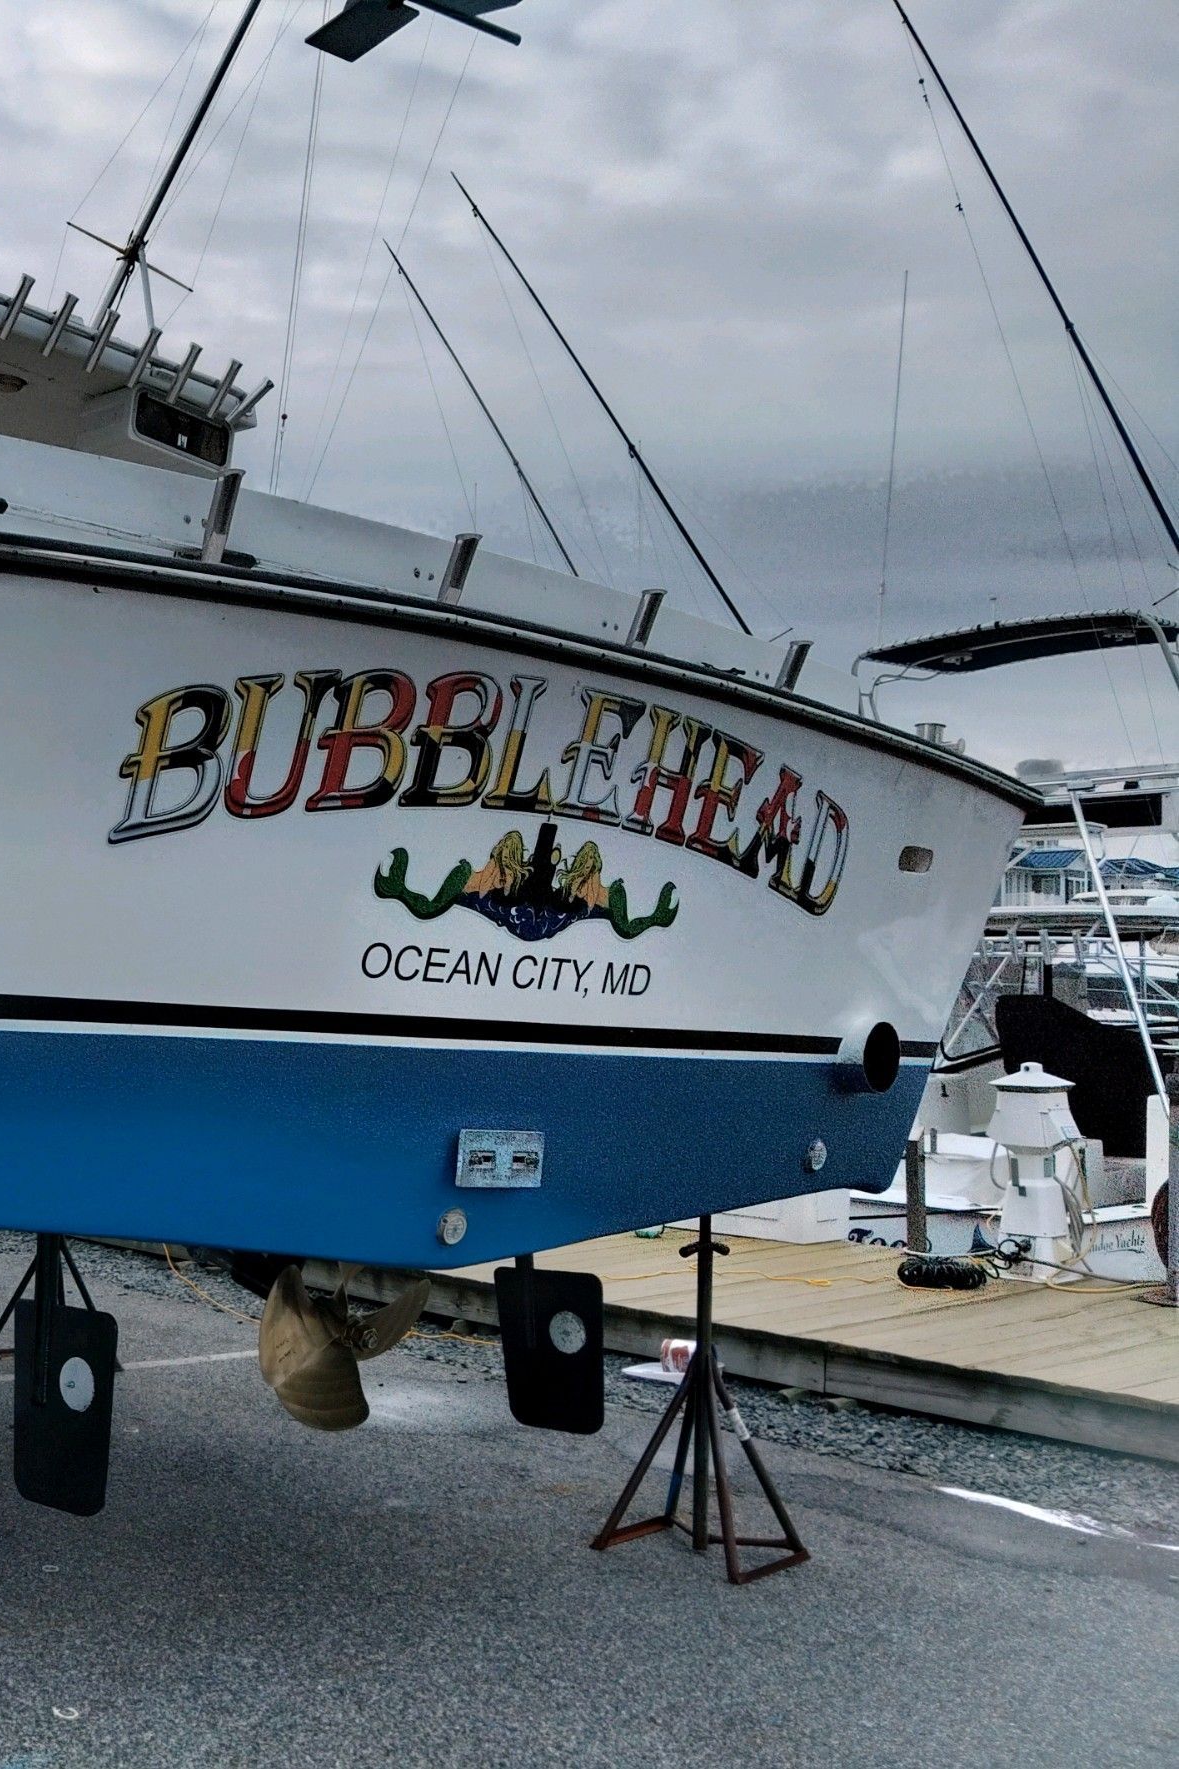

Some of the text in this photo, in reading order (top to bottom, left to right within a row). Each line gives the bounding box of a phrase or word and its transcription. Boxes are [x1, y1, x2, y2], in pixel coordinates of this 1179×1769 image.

[107, 667, 852, 917] BUBBLEHEAD
[361, 942, 651, 998] OCEAN CITY, MD
